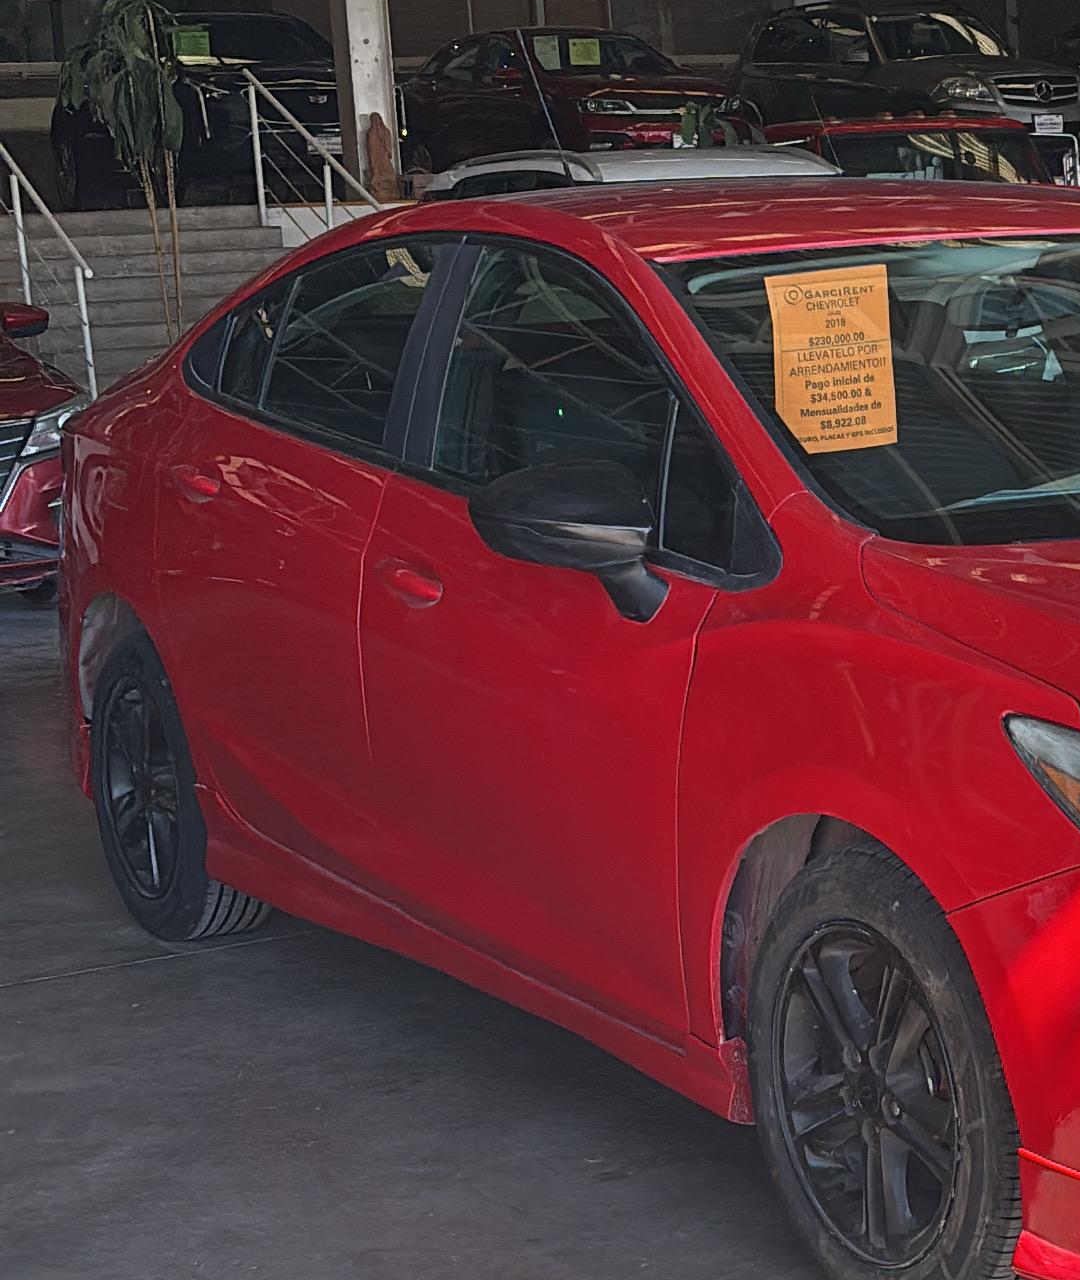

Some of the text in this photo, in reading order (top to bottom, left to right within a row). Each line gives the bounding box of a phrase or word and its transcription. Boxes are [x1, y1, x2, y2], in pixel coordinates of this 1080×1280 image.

[804, 285, 874, 299] GARCIRENT
[806, 296, 860, 311] CHEVROLET
[825, 318, 846, 328] 2018
[808, 332, 864, 347] $230,000.00
[797, 344, 878, 362] LLEVATELO POR
[805, 380, 830, 391] Pago
[863, 373, 875, 382] de
[810, 387, 872, 403] $34,500.00 &
[800, 400, 882, 418] Mensualidades de
[820, 416, 867, 430] $8,922.08
